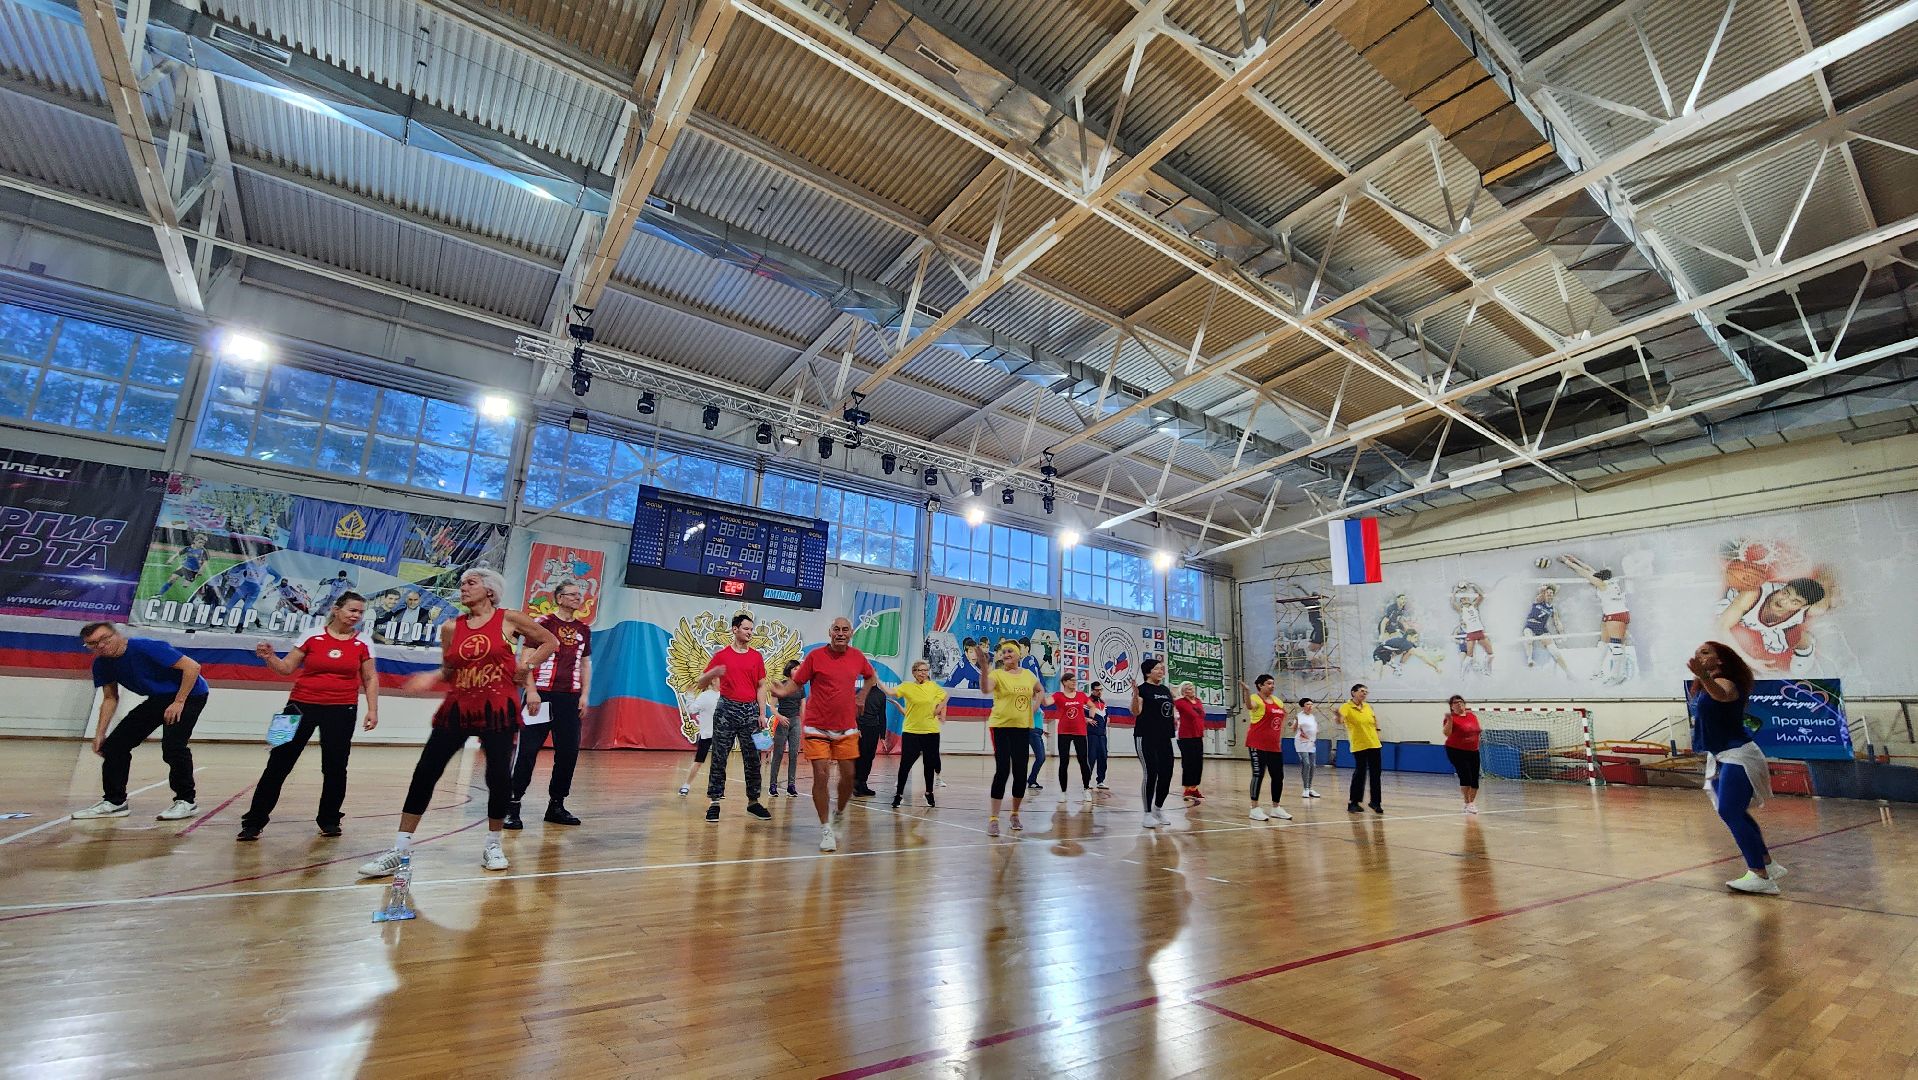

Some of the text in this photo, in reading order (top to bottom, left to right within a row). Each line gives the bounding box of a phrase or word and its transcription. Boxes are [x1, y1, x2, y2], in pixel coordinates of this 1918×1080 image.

[0, 505, 128, 544] РГИЯ
[0, 535, 107, 570] РТА
[341, 553, 386, 563] ПРОТВИНО
[6, 596, 121, 611] WWW.KAMTURBO.RU
[763, 588, 802, 602] ИМПУЛЬС
[144, 598, 258, 628] СПОНСОР
[384, 621, 442, 643] ПРОТ
[965, 602, 1029, 626] ГАНДБОЛ
[1099, 670, 1134, 692] ЭРИДАН
[1771, 716, 1836, 727] Протвино
[1776, 733, 1837, 744] Импульс
